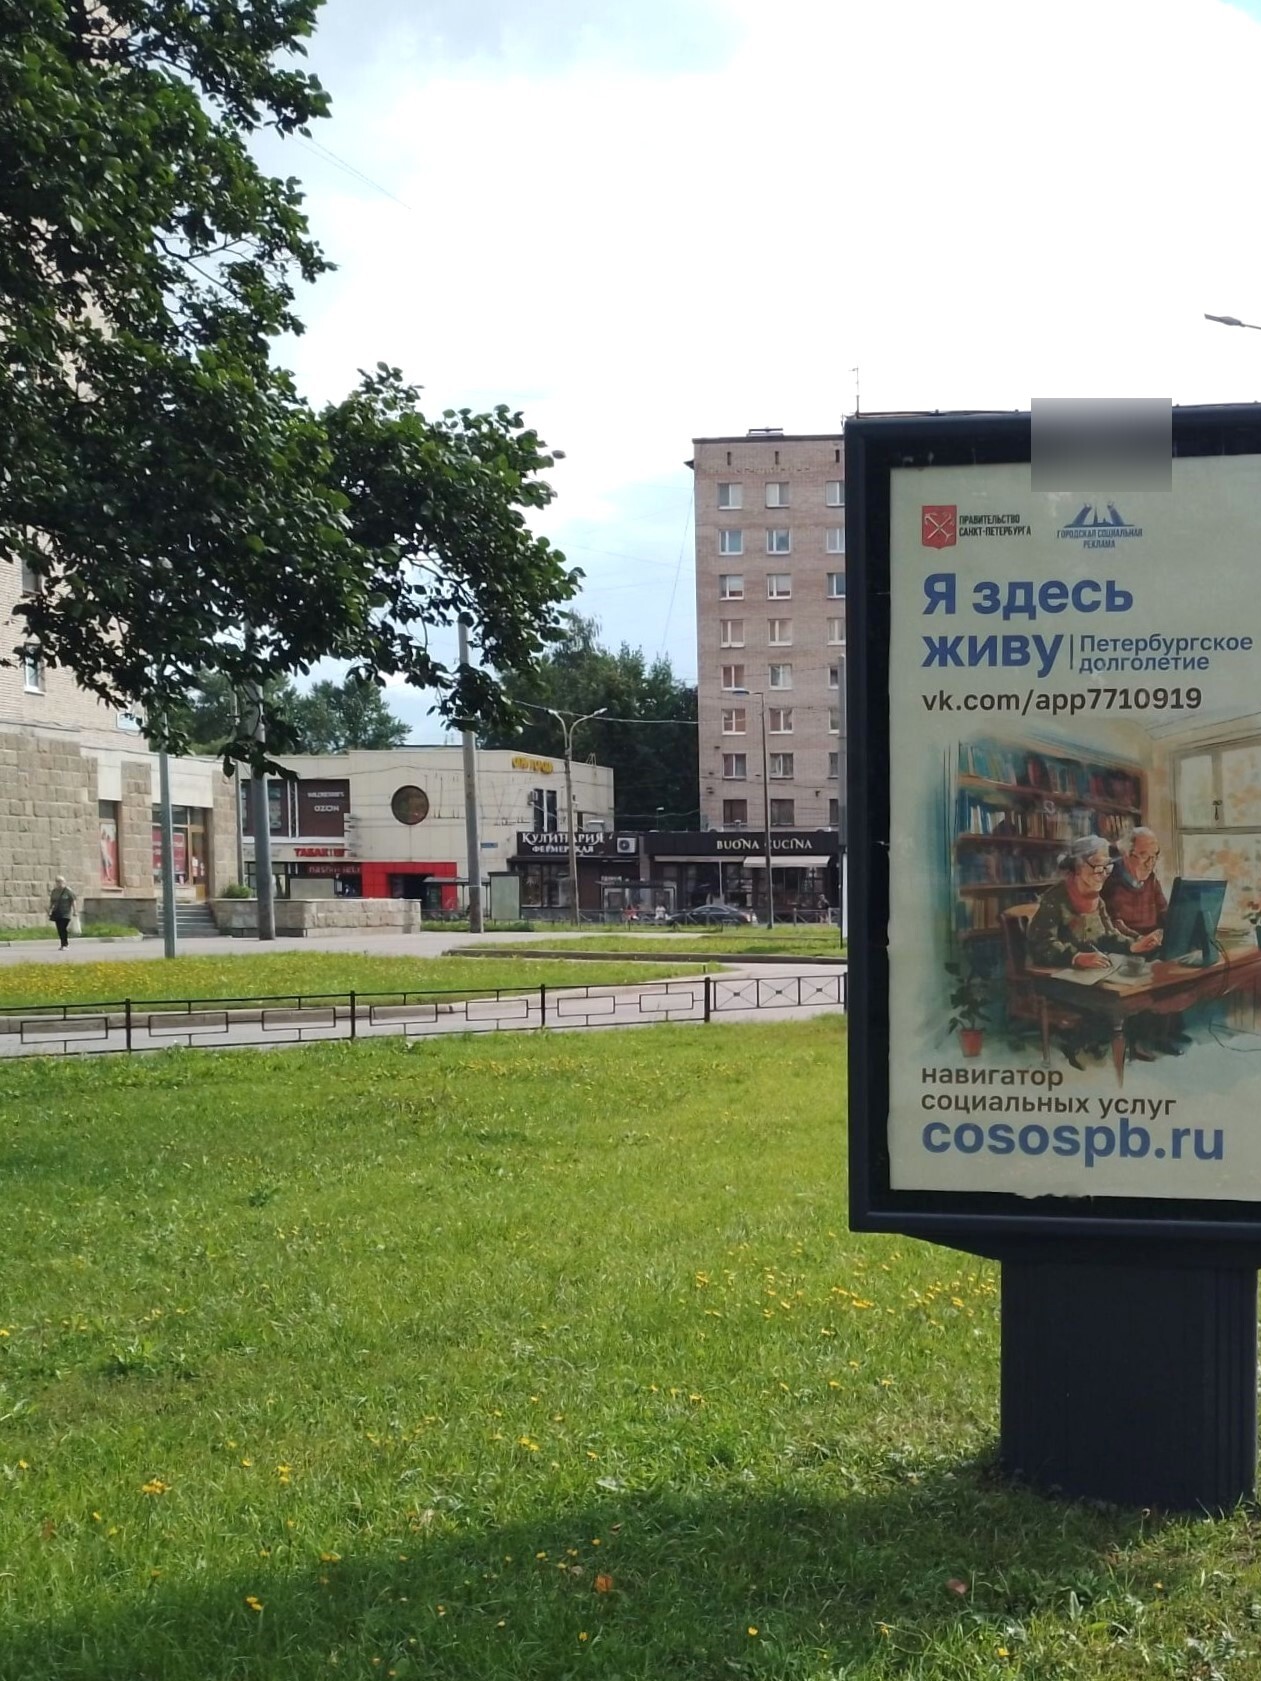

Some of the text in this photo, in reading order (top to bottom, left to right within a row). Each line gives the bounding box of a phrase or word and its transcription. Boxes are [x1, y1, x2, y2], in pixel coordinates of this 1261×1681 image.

[959, 514, 1020, 525] ПРАВИТЕЛЬСТВО
[959, 525, 1032, 537] САНКТ-ПЕТЕРБУРГА
[1056, 528, 1143, 539] ГОРОДСКАЯ СОЦИАЛЬНАЯ
[1083, 540, 1116, 549] РЕКЛАМА
[922, 573, 1134, 621] Я здесь
[1080, 633, 1254, 656] Петербургское
[921, 633, 1064, 678] живу
[1079, 654, 1210, 675] долголетие
[922, 687, 1202, 716] vk.com/app7710919
[314, 804, 340, 812] OZON
[532, 845, 594, 853] ФЕРМЕРКАЯ
[716, 838, 760, 850] BUONA
[921, 1067, 1064, 1091] навигатор
[921, 1093, 1177, 1120] социальных услуг
[922, 1117, 1225, 1168] cosospb.ru
